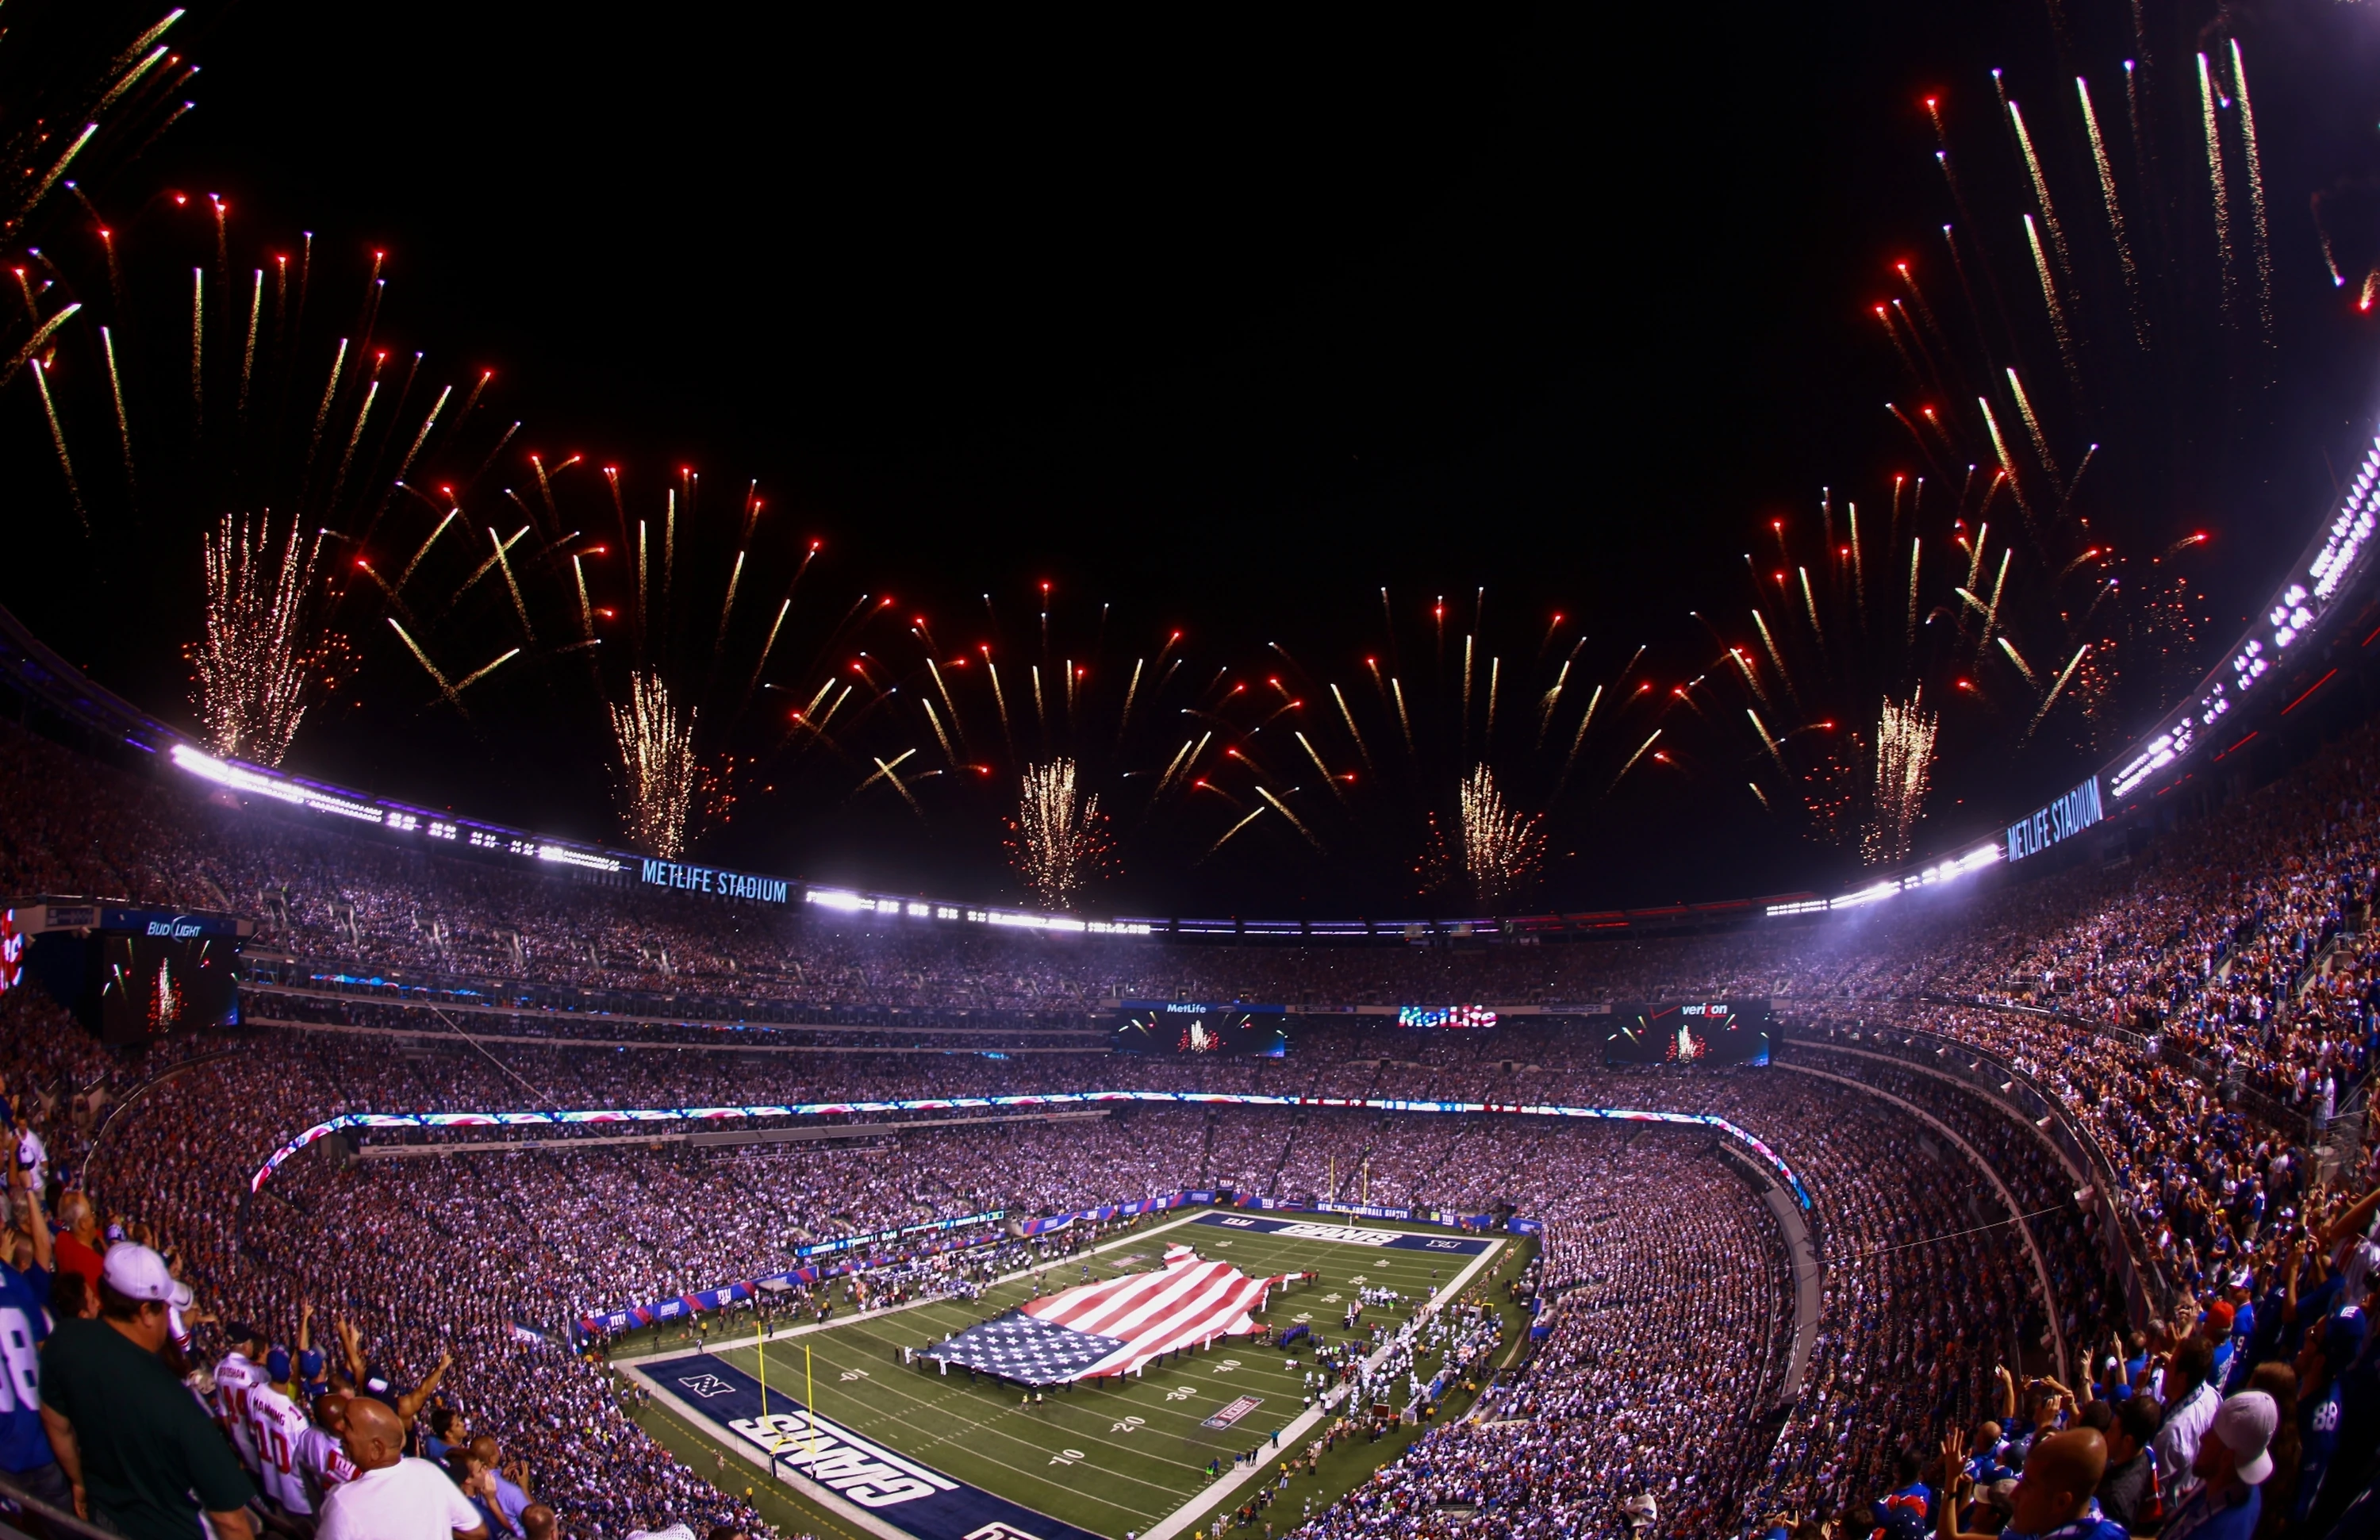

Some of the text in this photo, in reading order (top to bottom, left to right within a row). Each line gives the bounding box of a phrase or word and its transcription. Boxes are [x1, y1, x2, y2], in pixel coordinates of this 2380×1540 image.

[2007, 775, 2102, 862] METLIFE STADIUM
[642, 859, 786, 903] METLIFE STADIUM
[147, 921, 202, 937] BUD LIGHT
[1167, 1004, 1207, 1013] MetLife
[1399, 1005, 1497, 1027] MetLife
[1682, 1003, 1728, 1017] verizon
[1353, 1207, 1383, 1216] FOOTBALL
[1278, 1223, 1403, 1243] GIANTS
[1215, 1359, 1242, 1372] 40
[1167, 1386, 1197, 1400] 30
[253, 1396, 286, 1427] MANNING
[2313, 1401, 2338, 1431] 88
[1113, 1416, 1146, 1432] 20
[255, 1420, 290, 1474] 10
[728, 1413, 936, 1507] GIANTS
[1052, 1449, 1084, 1465] 10
